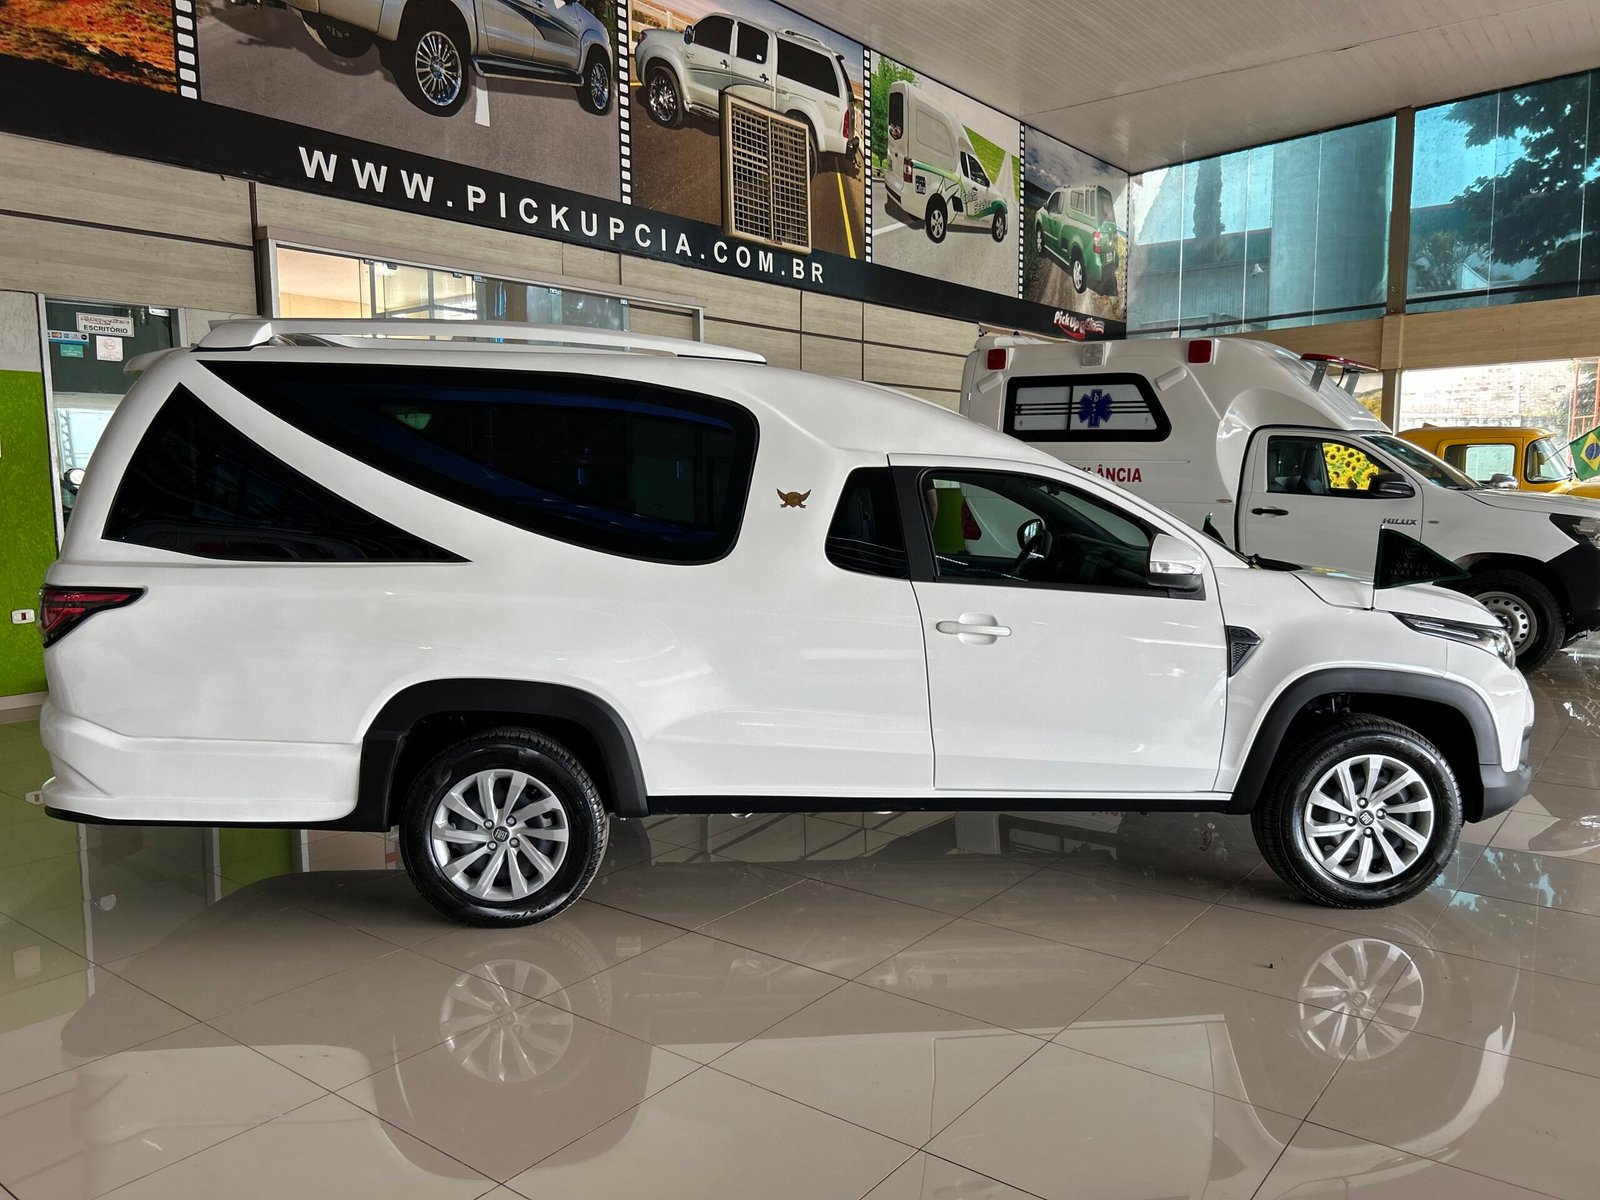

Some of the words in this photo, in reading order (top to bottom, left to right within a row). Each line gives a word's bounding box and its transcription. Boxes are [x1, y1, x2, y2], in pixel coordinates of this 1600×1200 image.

[298, 146, 825, 285] WWW.PICKUPCIA.COM.BR
[83, 325, 128, 334] ESCRITÓRIO
[1083, 464, 1142, 482] ÂNCIA
[1382, 517, 1418, 525] HILUX
[495, 829, 508, 841] FIAT
